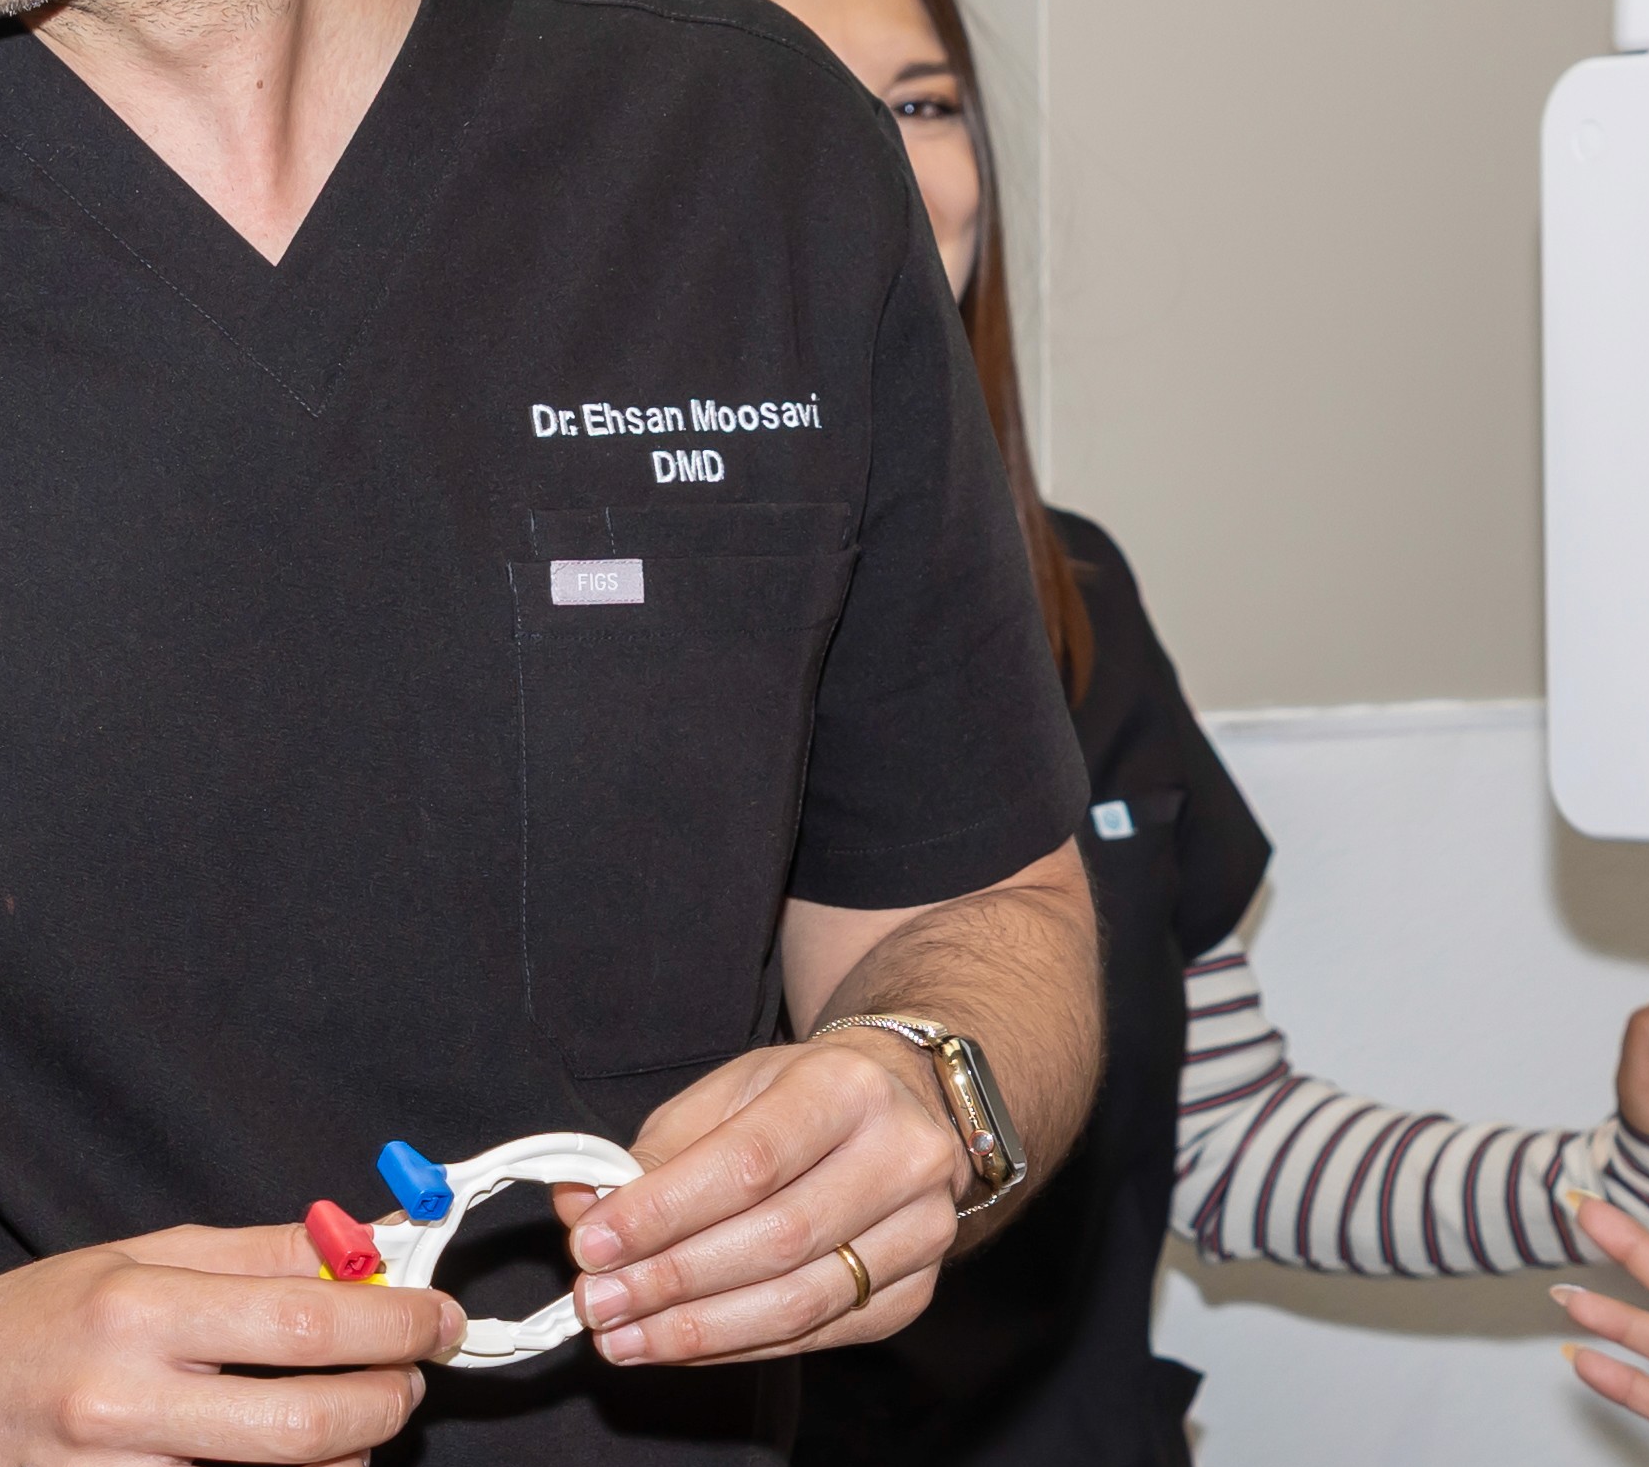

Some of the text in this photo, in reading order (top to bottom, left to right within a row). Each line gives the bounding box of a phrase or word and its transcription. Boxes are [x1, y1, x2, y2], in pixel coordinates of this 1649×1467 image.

[580, 401, 687, 437] Ehsan
[690, 392, 823, 434] Moosavi
[651, 449, 725, 483] DMD
[577, 572, 619, 592] FIGS
